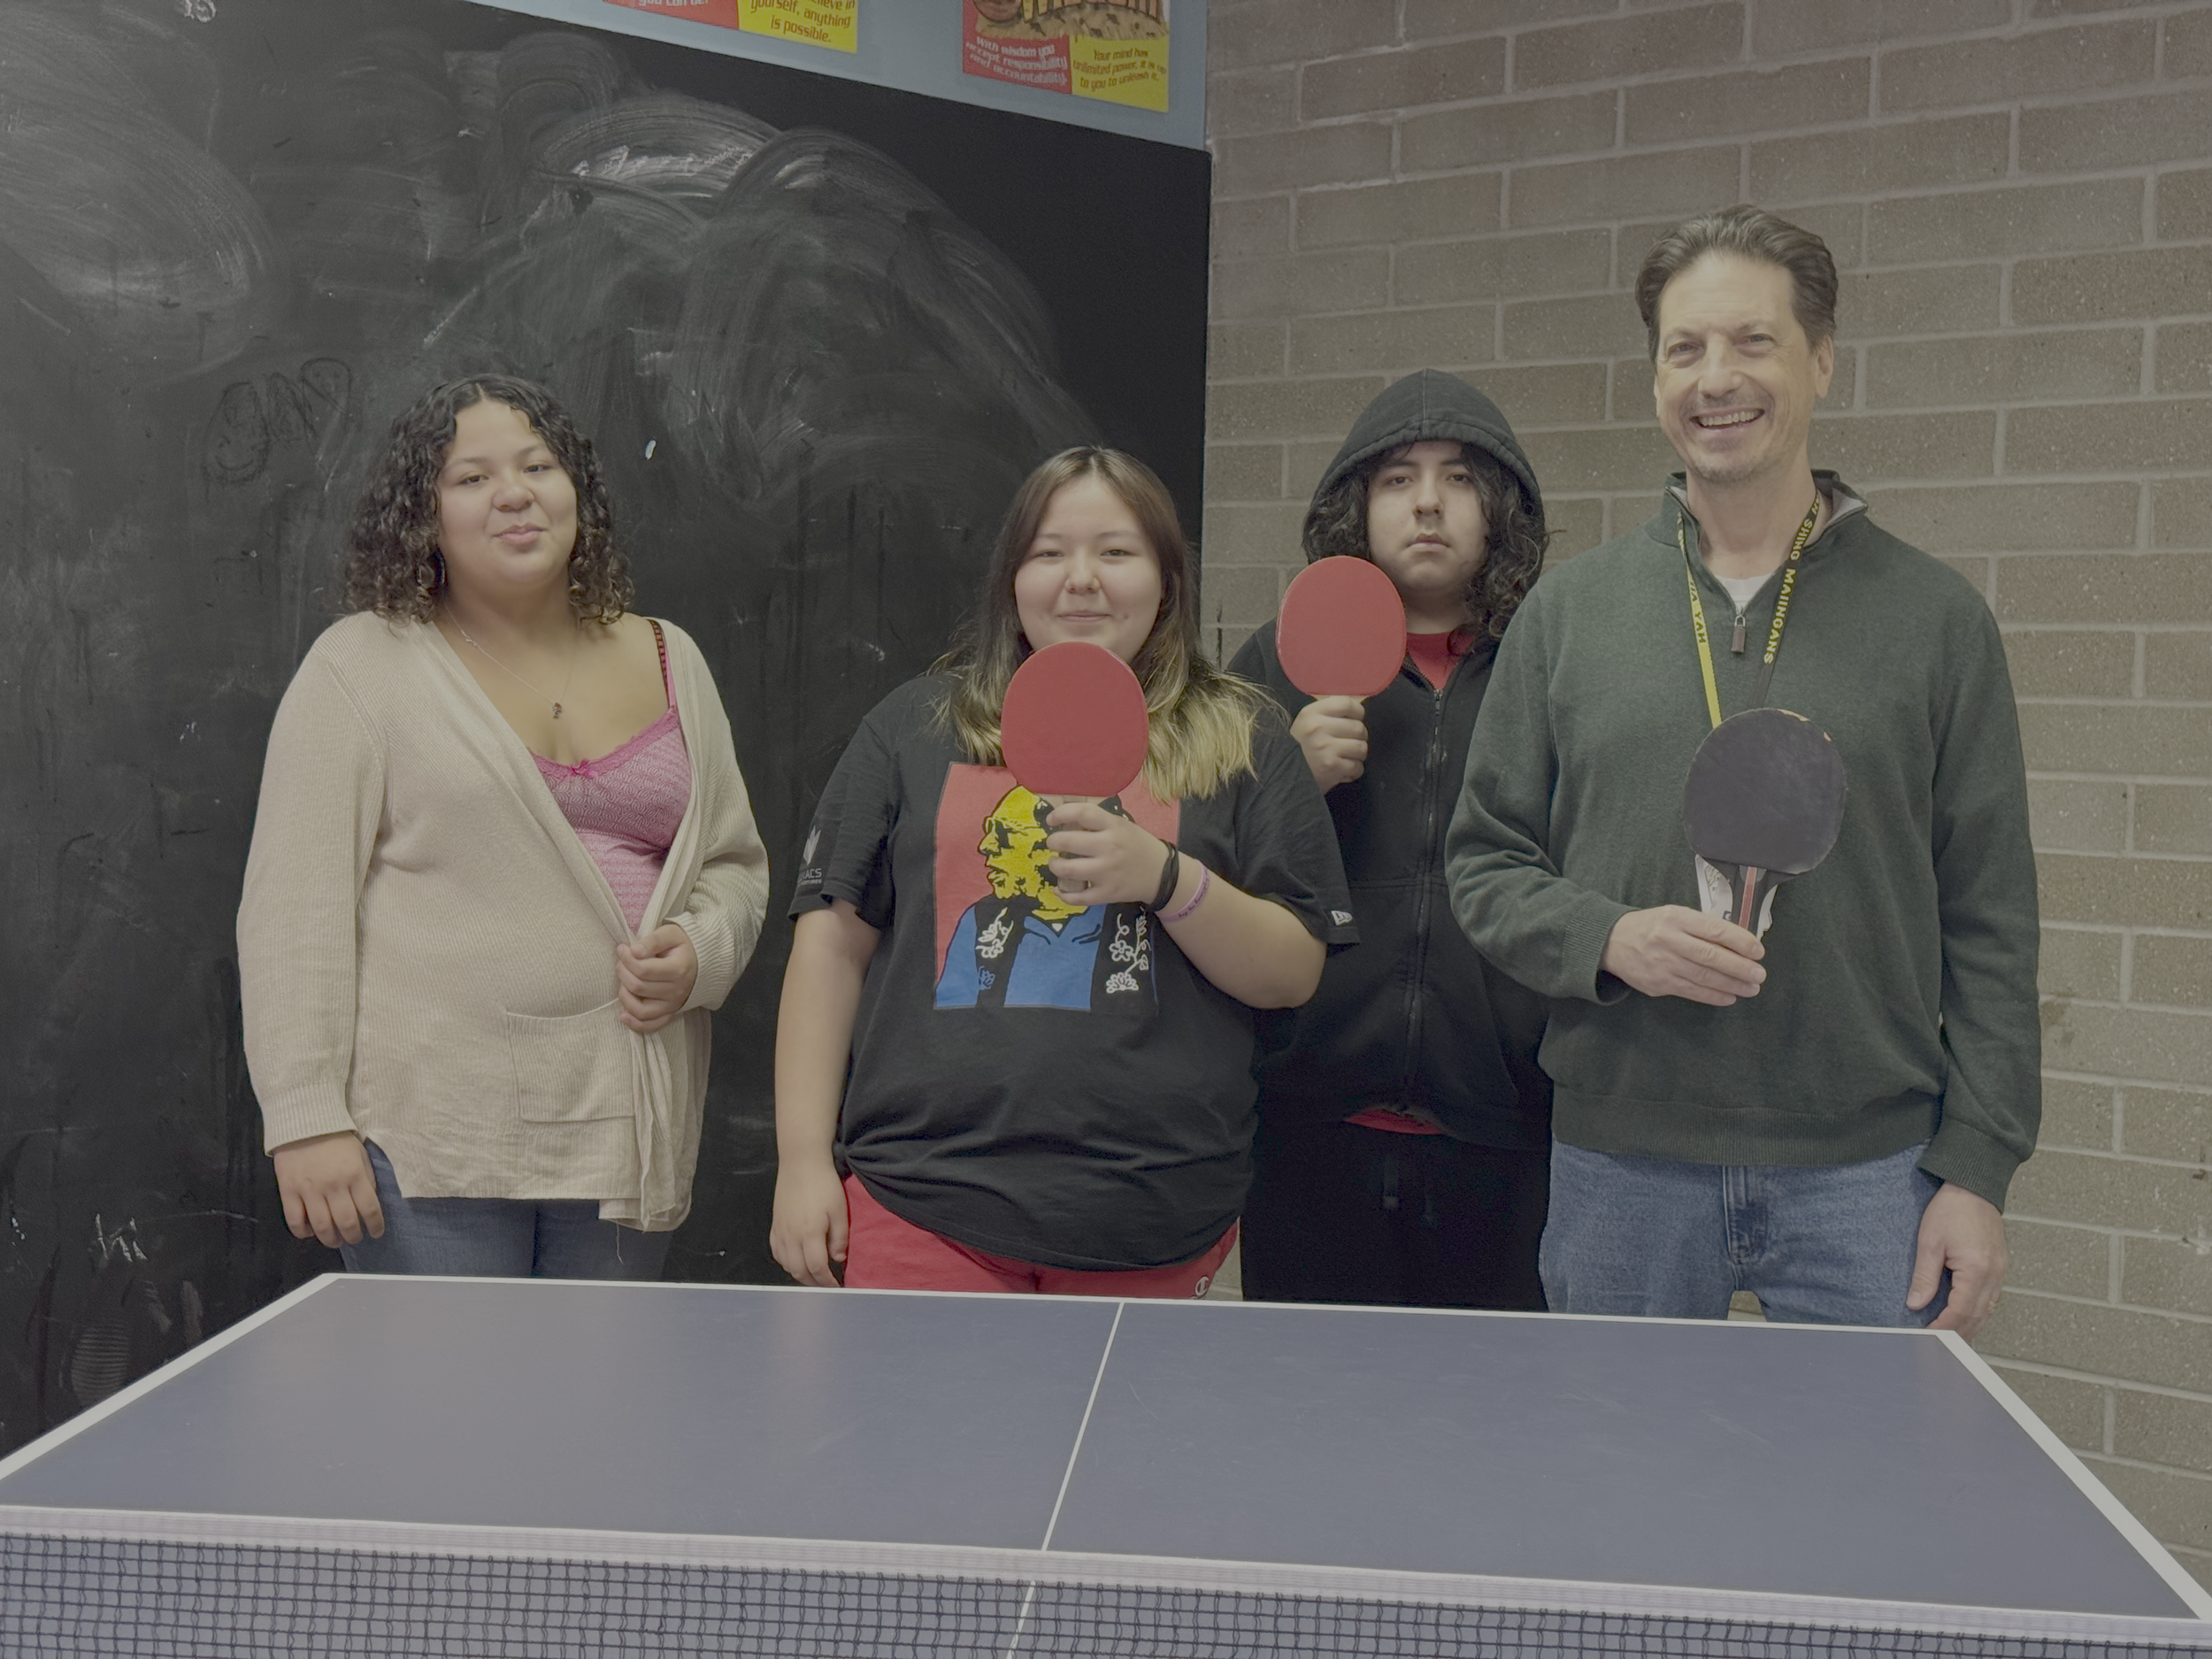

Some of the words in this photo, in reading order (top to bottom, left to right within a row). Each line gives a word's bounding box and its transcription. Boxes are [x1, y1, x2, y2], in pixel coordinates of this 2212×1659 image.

[771, 15, 781, 30] is
[783, 19, 832, 42] possible.
[804, 8, 851, 29] anything
[965, 42, 1000, 62] accept
[1002, 56, 1067, 70] responsibility
[976, 36, 999, 52] With
[1001, 46, 1037, 58] wisdom
[1038, 44, 1056, 60] you
[1112, 48, 1133, 60] mind
[1134, 48, 1148, 58] has
[970, 53, 991, 68] and
[1148, 60, 1156, 69] is
[1079, 76, 1089, 88] to
[1090, 80, 1106, 92] you
[1108, 77, 1117, 87] to
[1118, 71, 1149, 84] unleash
[1790, 518, 1813, 561] SHING
[1763, 568, 1796, 664] MAIINGANS
